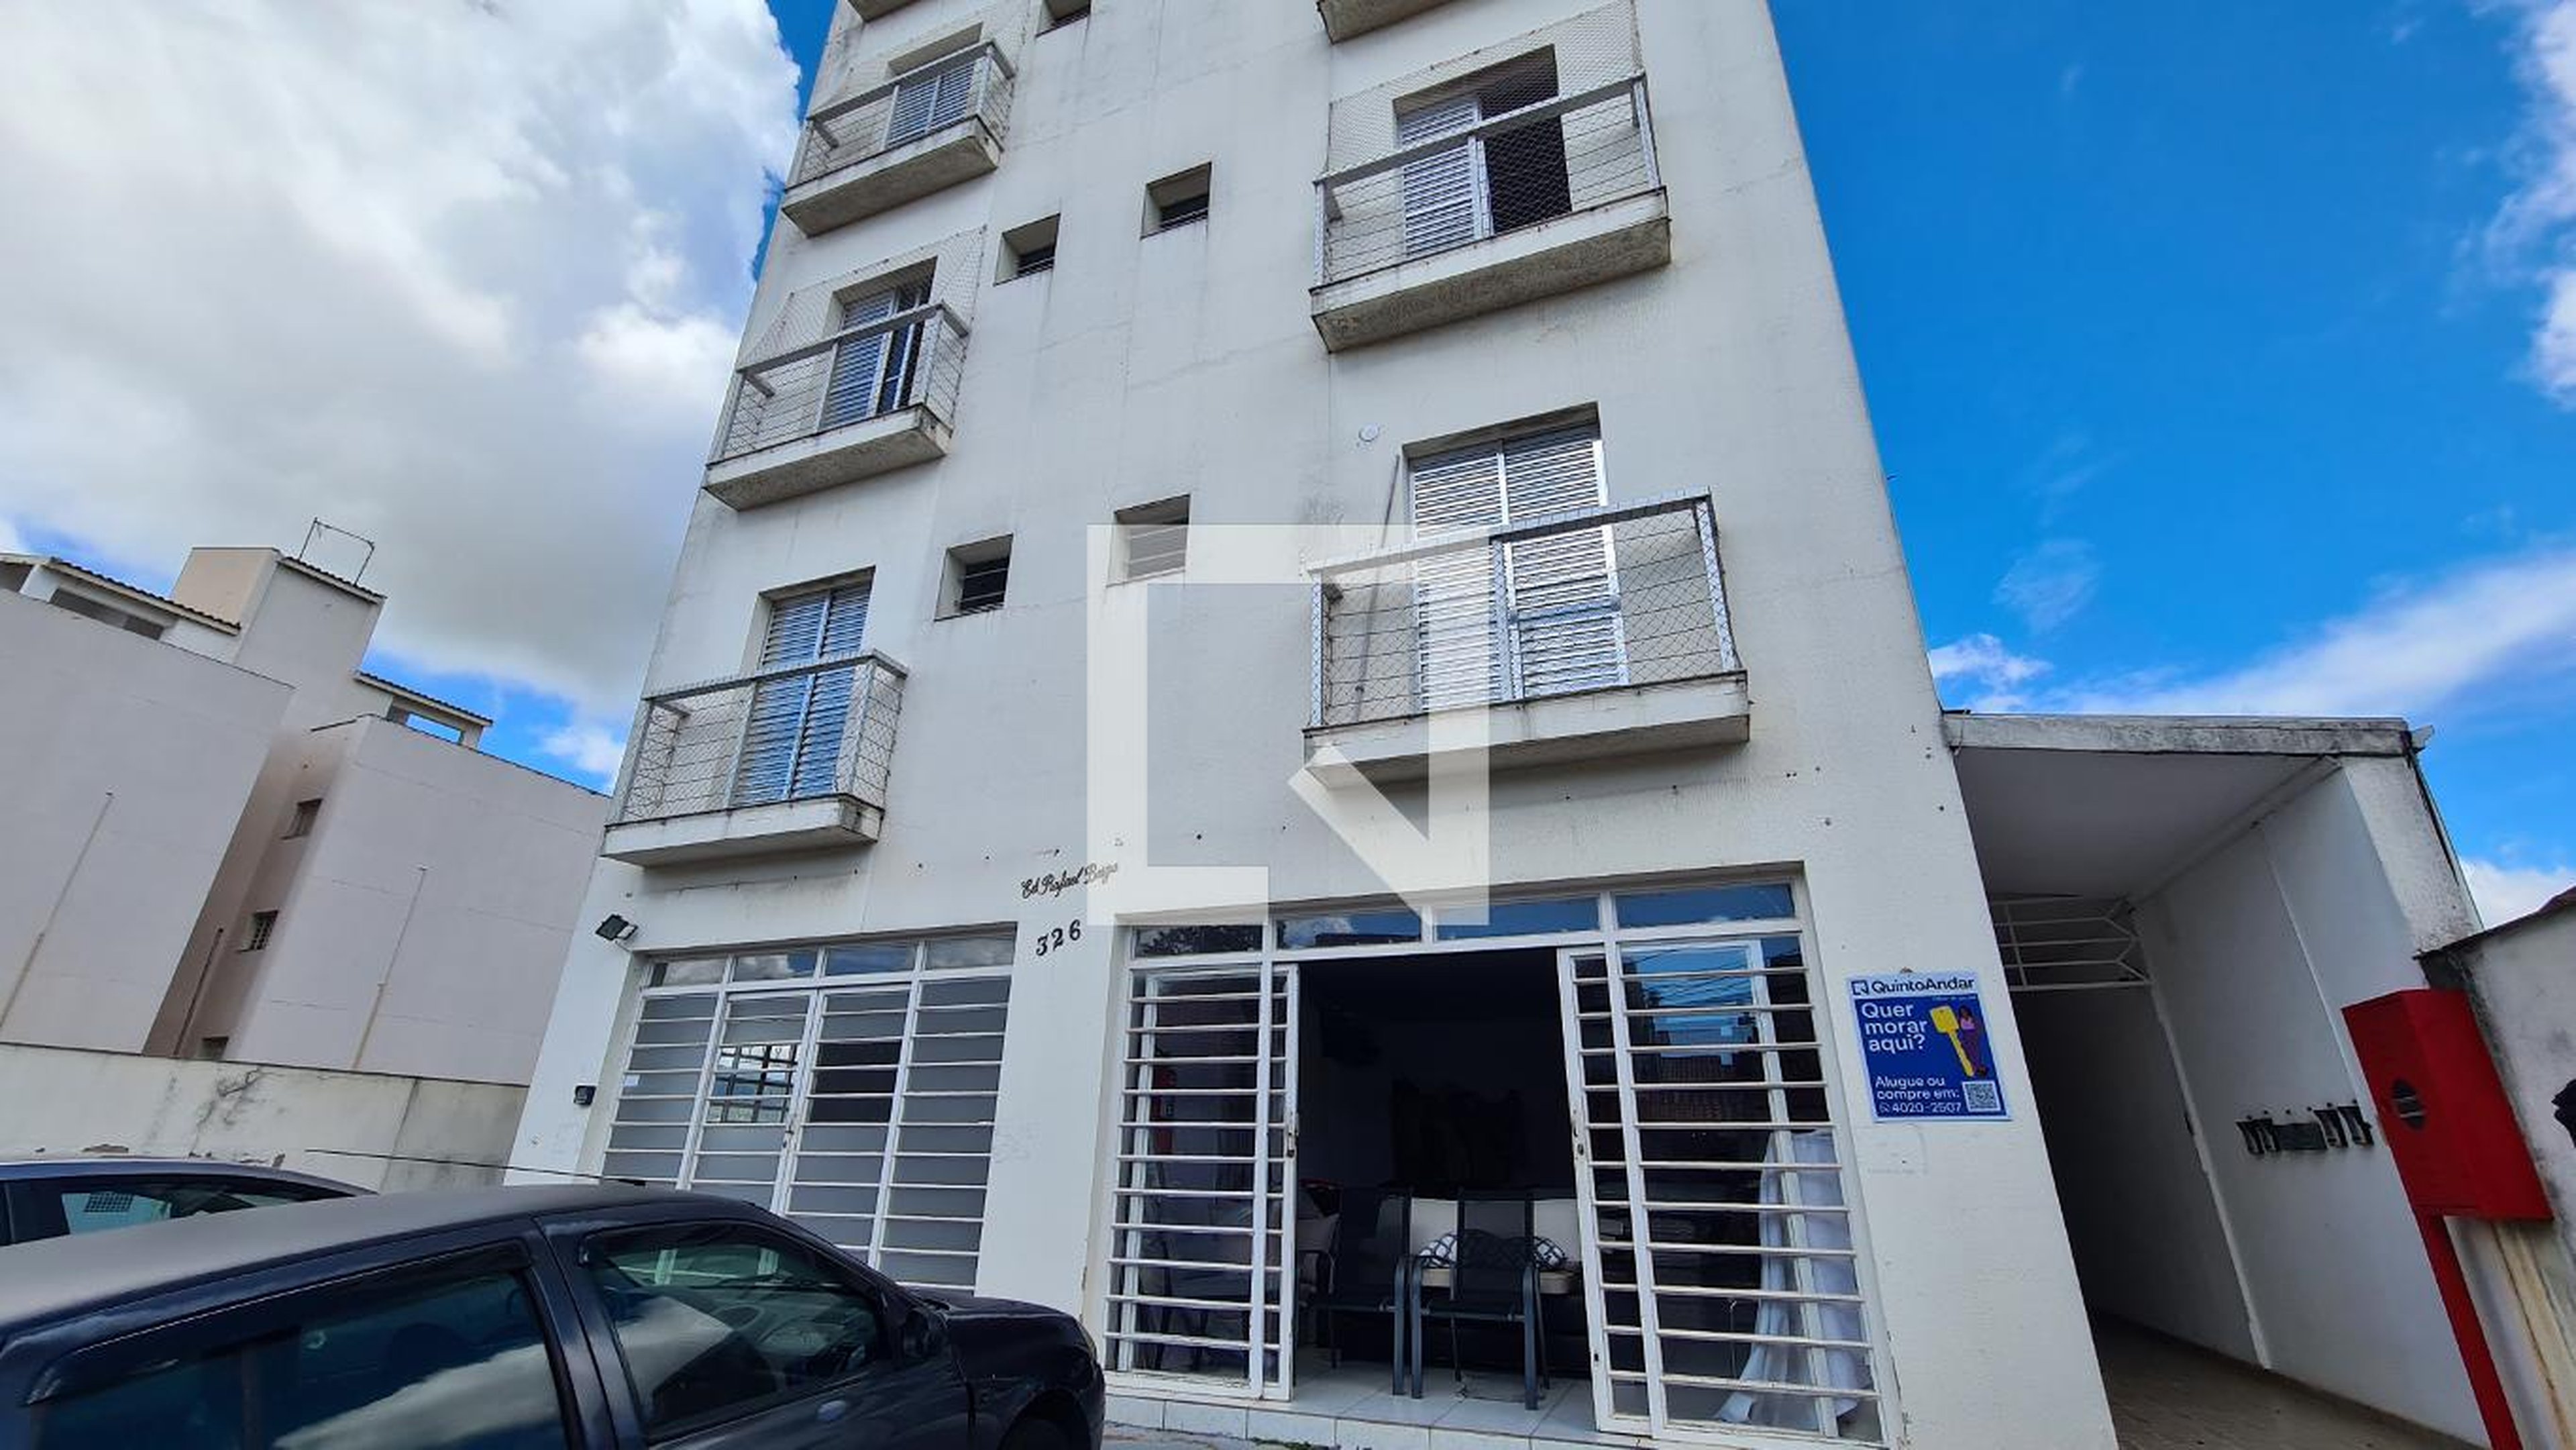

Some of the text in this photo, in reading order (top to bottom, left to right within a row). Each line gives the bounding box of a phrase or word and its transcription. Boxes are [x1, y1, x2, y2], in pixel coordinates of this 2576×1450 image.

[1036, 919, 1081, 956] 326
[1871, 977, 1974, 994] QuintoAndar
[1861, 1002, 1914, 1019] Quer
[1865, 1020, 1927, 1035] morar
[1869, 1033, 1925, 1054] aqui?
[1876, 1076, 1945, 1090] Alugue ou
[1877, 1089, 1960, 1100] compre em:
